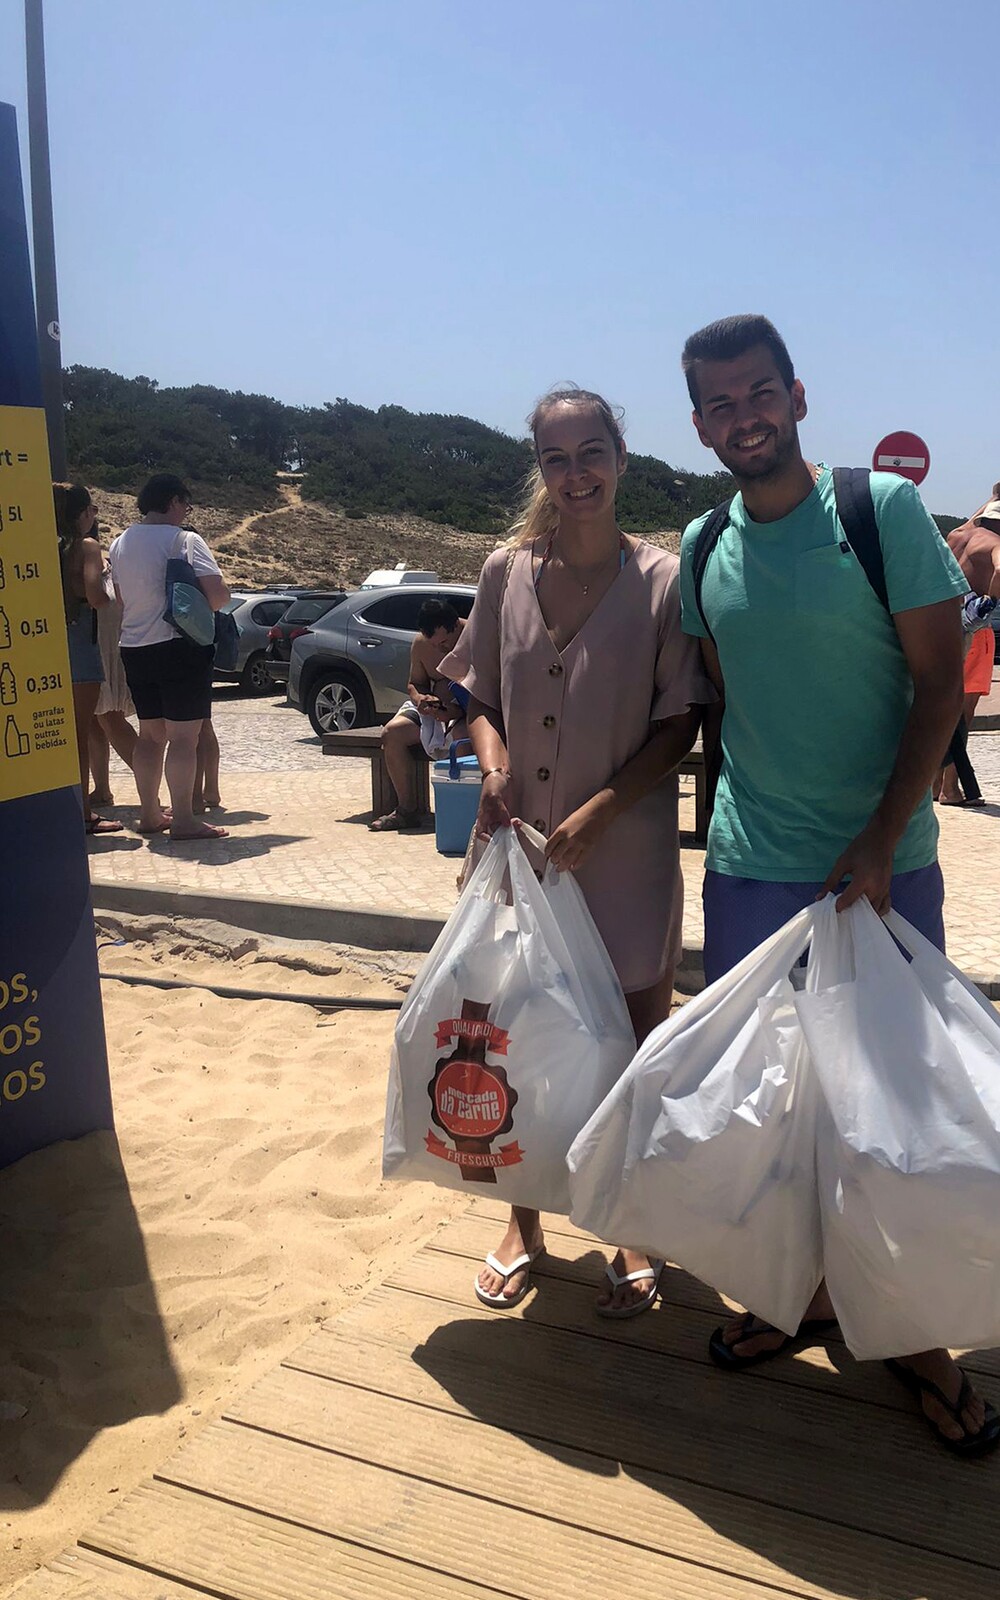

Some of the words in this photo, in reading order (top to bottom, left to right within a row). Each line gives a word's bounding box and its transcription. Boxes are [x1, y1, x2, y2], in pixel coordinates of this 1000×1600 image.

[20, 618, 48, 638] 0,5l
[26, 673, 63, 694] 0,33l
[32, 706, 65, 721] garrafas
[33, 721, 44, 730] ou
[45, 718, 65, 727] latas
[34, 729, 60, 740] outras
[35, 738, 67, 751] bebidas
[452, 1020, 494, 1037] QUALIDAD
[3, 1060, 46, 1101] OS
[448, 1086, 498, 1104] mercado
[440, 1090, 455, 1116] da
[457, 1100, 501, 1121] carne
[447, 1150, 505, 1167] FRESCURA
